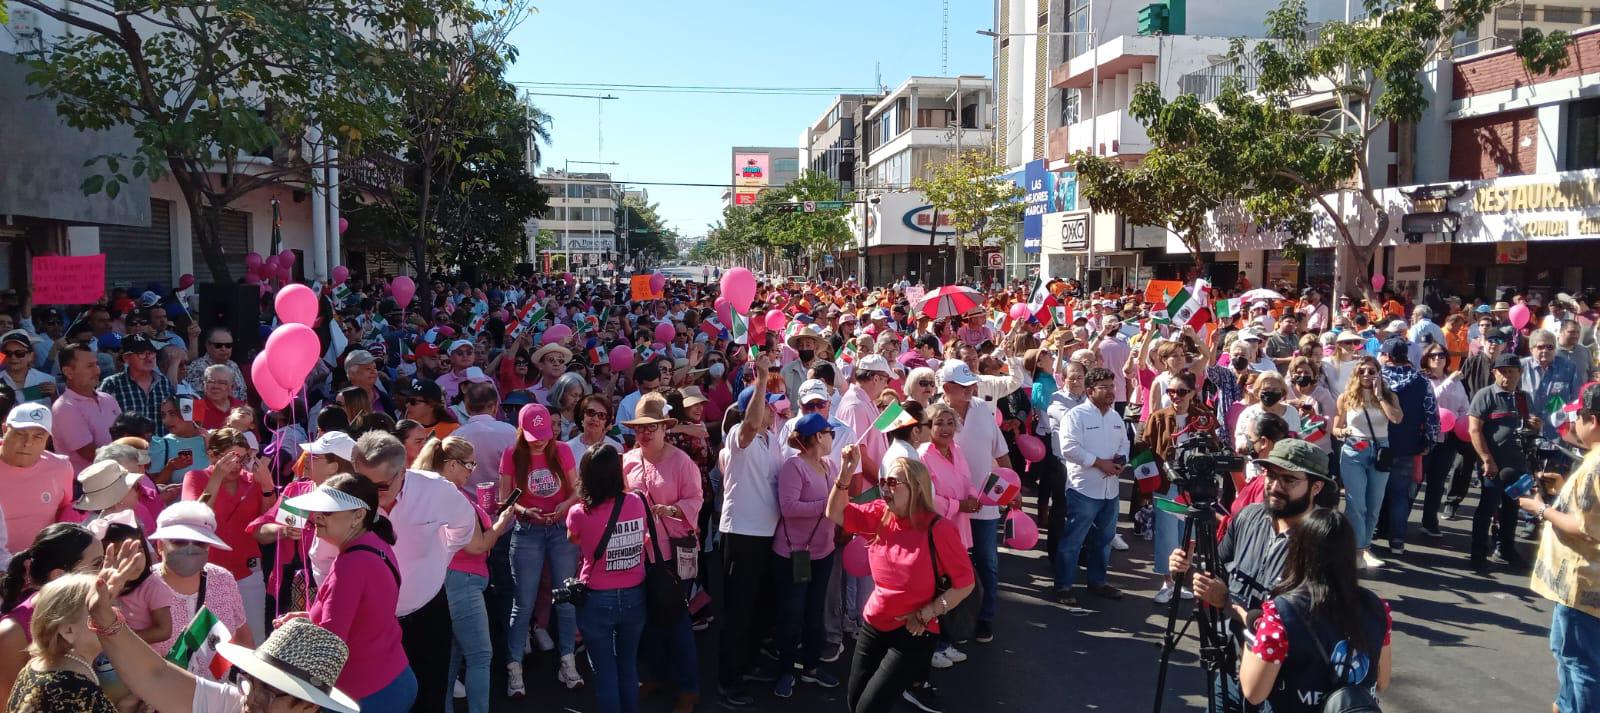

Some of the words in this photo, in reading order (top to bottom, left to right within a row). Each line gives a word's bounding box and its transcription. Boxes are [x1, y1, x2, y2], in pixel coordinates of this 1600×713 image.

[1031, 179, 1042, 190] LAS
[1062, 221, 1084, 242] OXXO
[624, 522, 630, 533] A
[630, 520, 639, 532] LA
